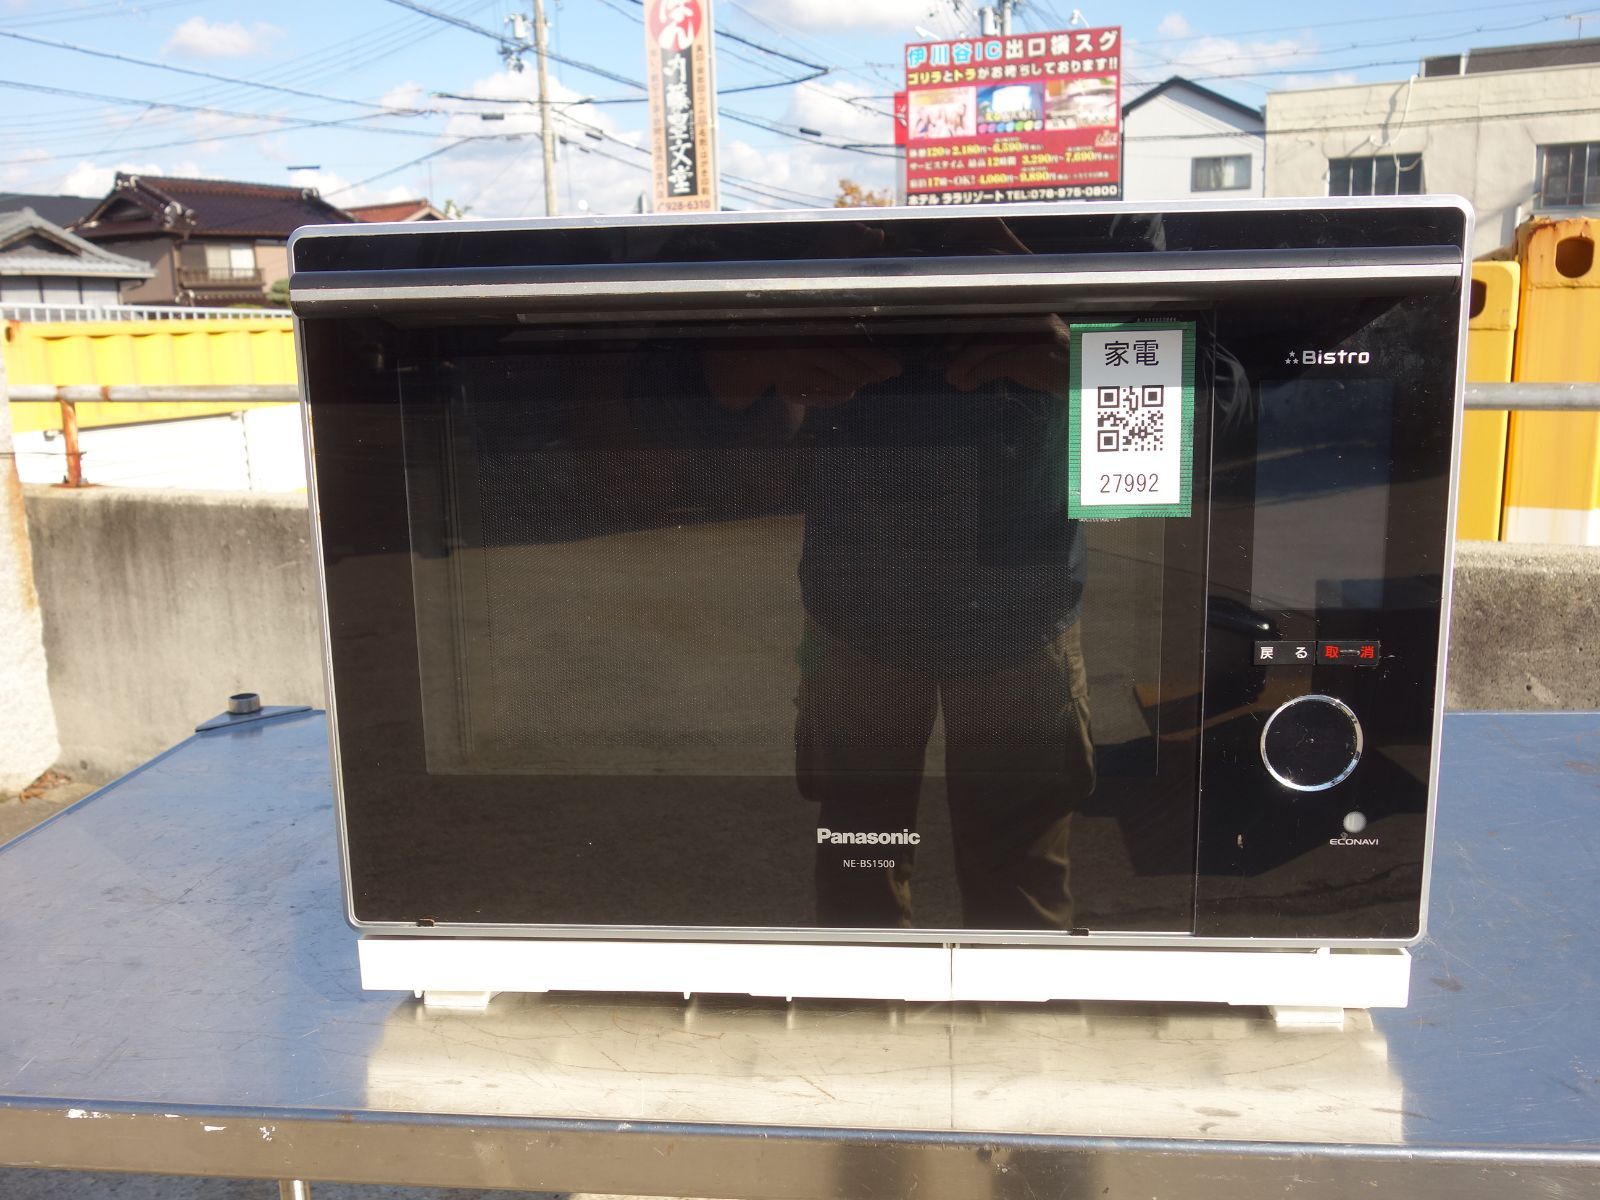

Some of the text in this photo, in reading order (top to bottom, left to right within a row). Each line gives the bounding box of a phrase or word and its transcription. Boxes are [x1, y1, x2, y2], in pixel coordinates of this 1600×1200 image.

[1105, 339, 1159, 367] 家電
[1302, 349, 1370, 365] Bistro
[1100, 473, 1159, 493] 27992
[816, 828, 921, 845] Panasonic
[1329, 838, 1379, 846] ECONAVI
[843, 859, 895, 868] NE-BS1500
